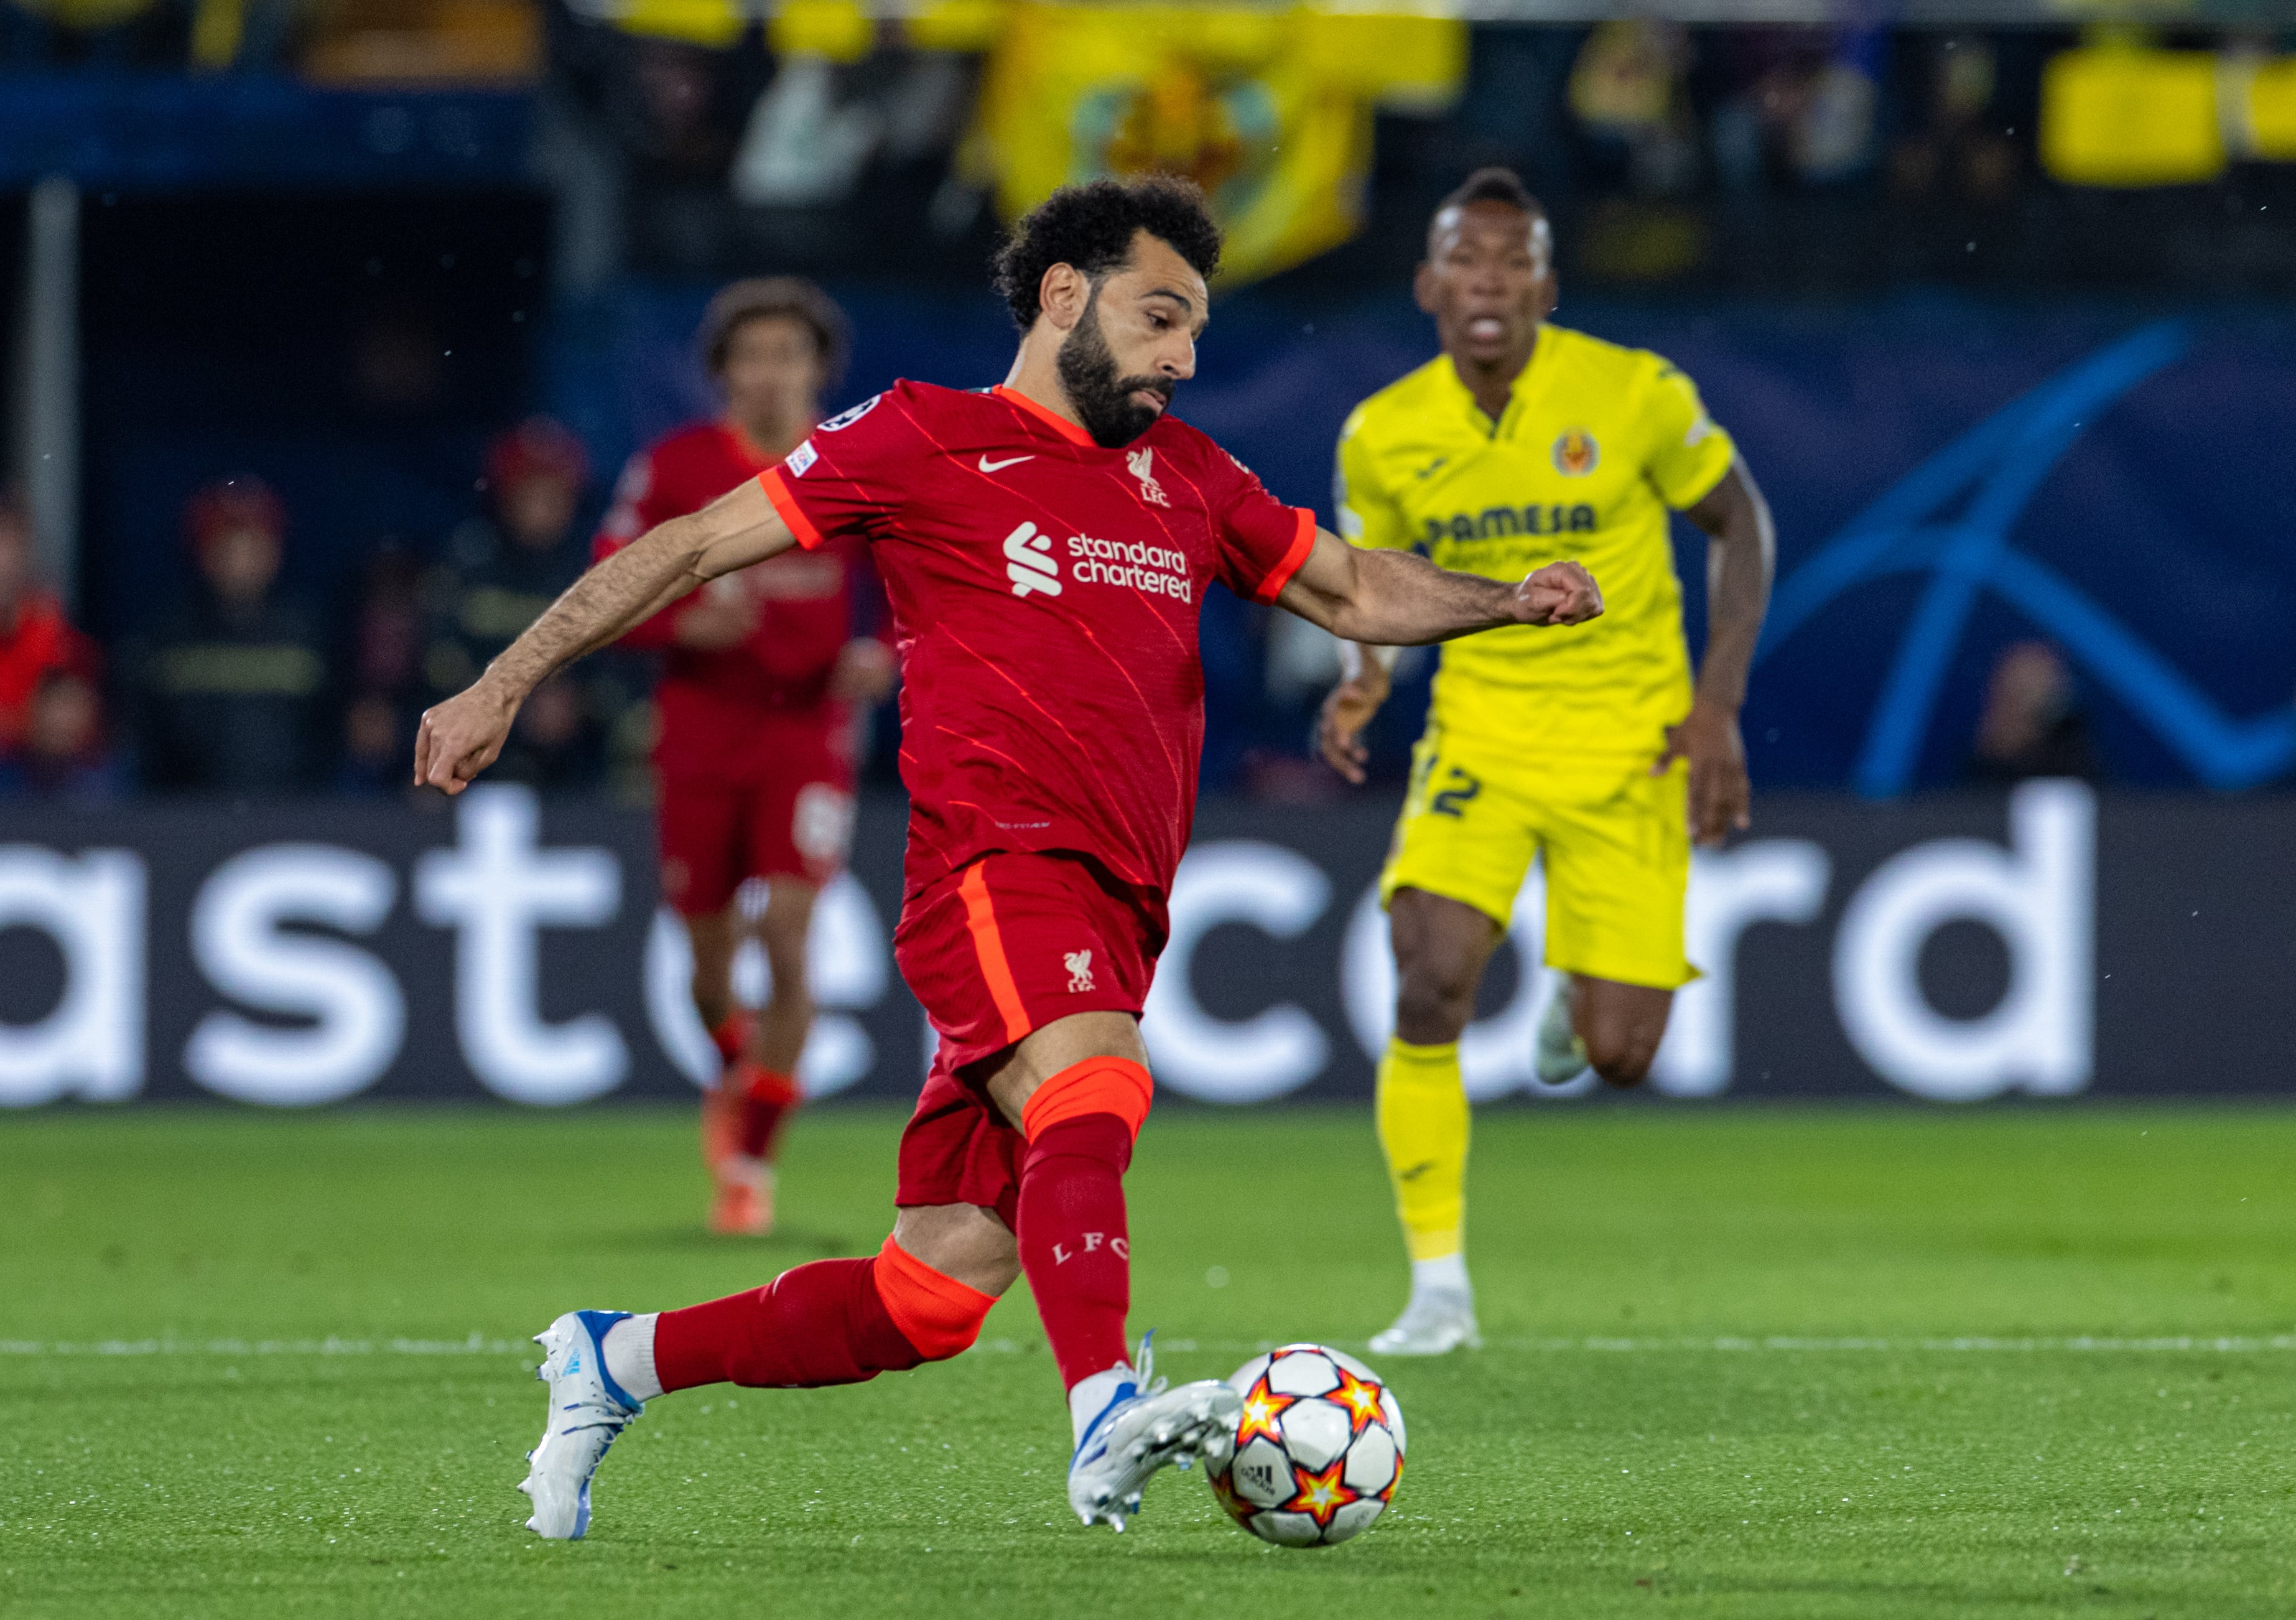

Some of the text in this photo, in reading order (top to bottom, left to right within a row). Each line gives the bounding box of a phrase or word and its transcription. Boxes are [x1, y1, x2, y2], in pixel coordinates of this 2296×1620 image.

[1067, 533, 1186, 575] standard
[1072, 558, 1191, 604] chartered
[1051, 1232, 1129, 1266] LFC
